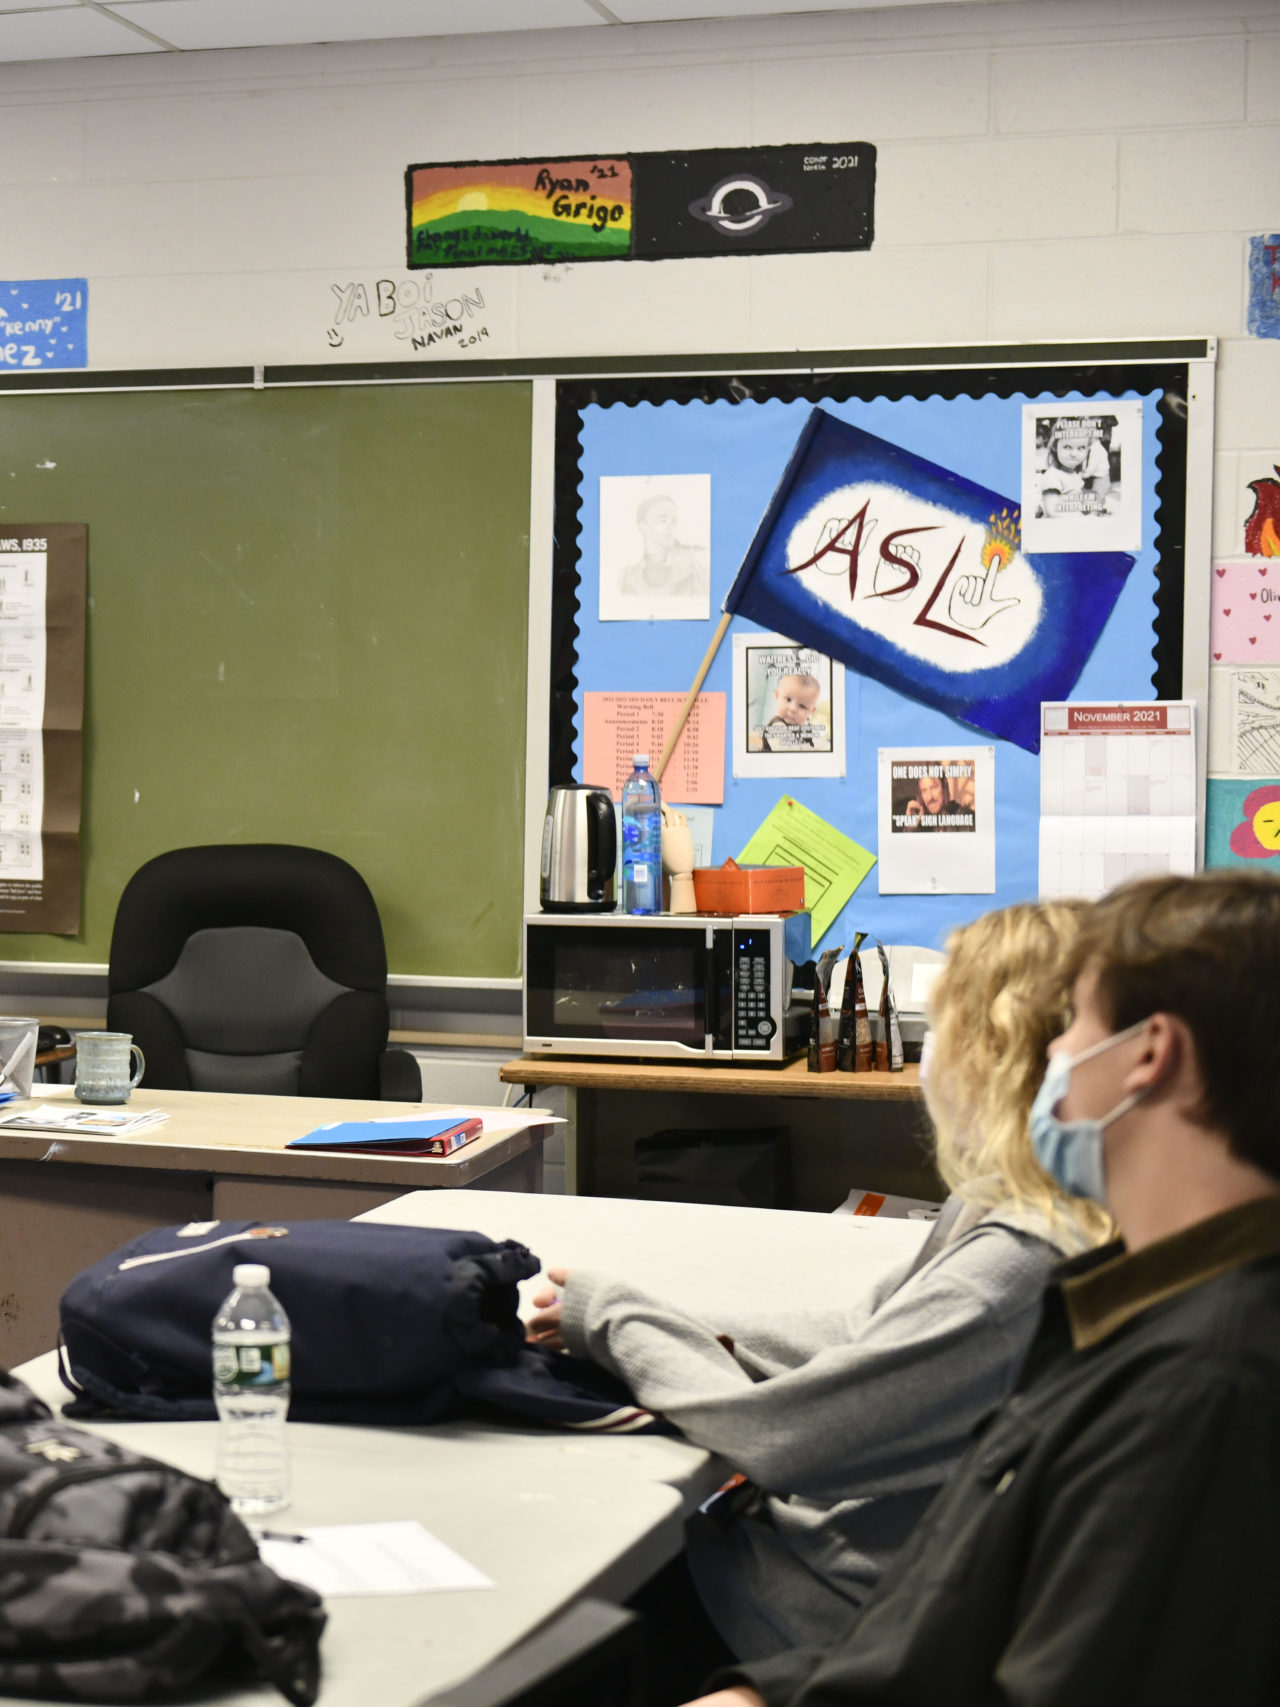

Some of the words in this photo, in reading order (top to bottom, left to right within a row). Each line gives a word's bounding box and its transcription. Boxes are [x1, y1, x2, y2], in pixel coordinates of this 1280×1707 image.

[832, 155, 858, 168] 2021
[534, 169, 589, 199] Ryan
[590, 165, 619, 179] '21
[552, 195, 624, 233] Grigo
[55, 291, 81, 312] '21
[411, 324, 463, 351] NAVAN
[457, 327, 490, 348] 2019
[22, 538, 48, 551] 1935
[776, 497, 988, 647] ASL
[1133, 710, 1161, 722] 2021
[893, 765, 907, 779] ONE
[908, 765, 928, 779] DOES
[928, 765, 944, 778] NOT
[945, 764, 972, 778] SIMPLY
[893, 814, 920, 827] "SPEAK"
[921, 814, 937, 827] SIGN
[938, 814, 973, 826] LANGUAGE
